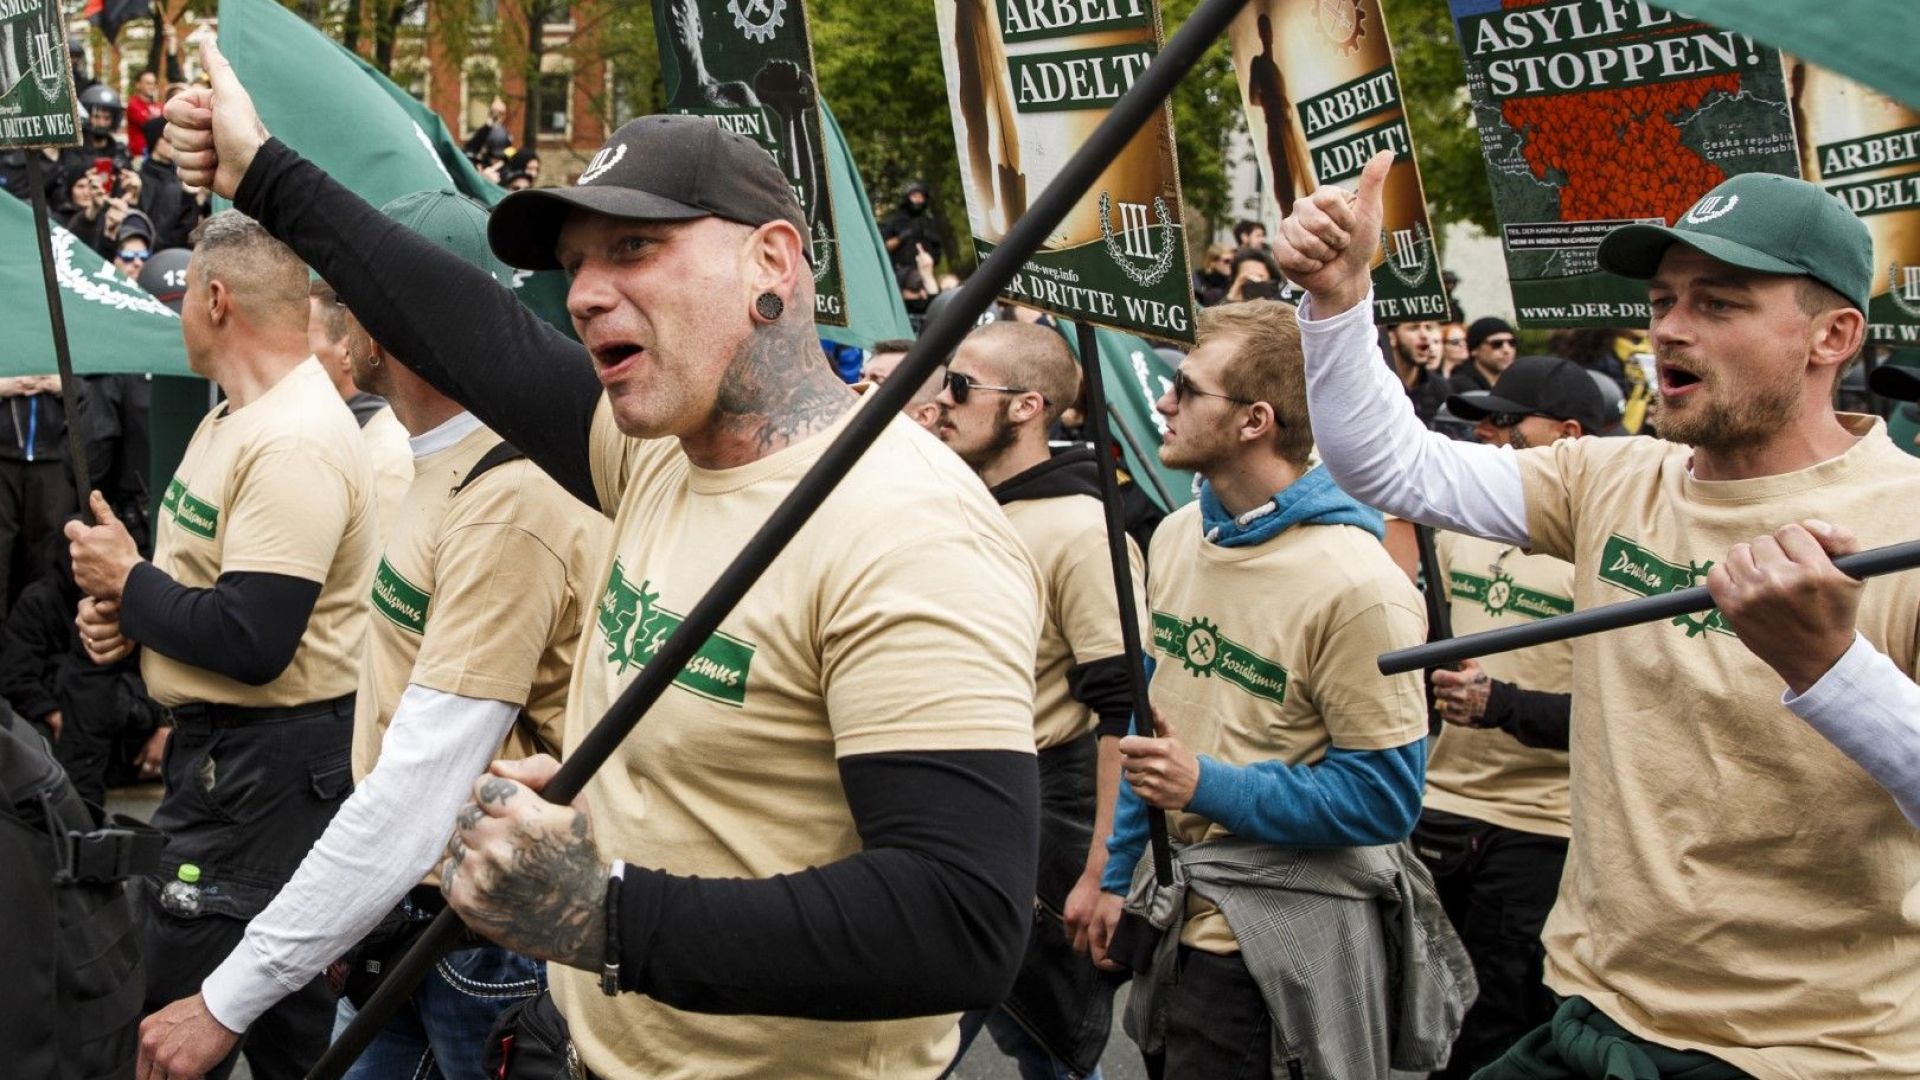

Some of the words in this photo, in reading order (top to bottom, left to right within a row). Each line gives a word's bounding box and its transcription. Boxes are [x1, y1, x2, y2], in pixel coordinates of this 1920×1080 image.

[1005, 0, 1144, 34] ARBEIT
[1473, 0, 1699, 55] ASYLFL
[1488, 30, 1760, 96] STOPPEN!
[1306, 71, 1396, 135] ARBEIT
[43, 112, 75, 136] WEG
[1706, 147, 1745, 160] Czech
[815, 293, 840, 315] EG
[1029, 275, 1117, 318] DRITTE
[1122, 295, 1188, 332] WEG
[1402, 295, 1444, 316] WEG
[1521, 302, 1654, 319] www.DER-DR
[1220, 651, 1284, 693] Sozialismus
